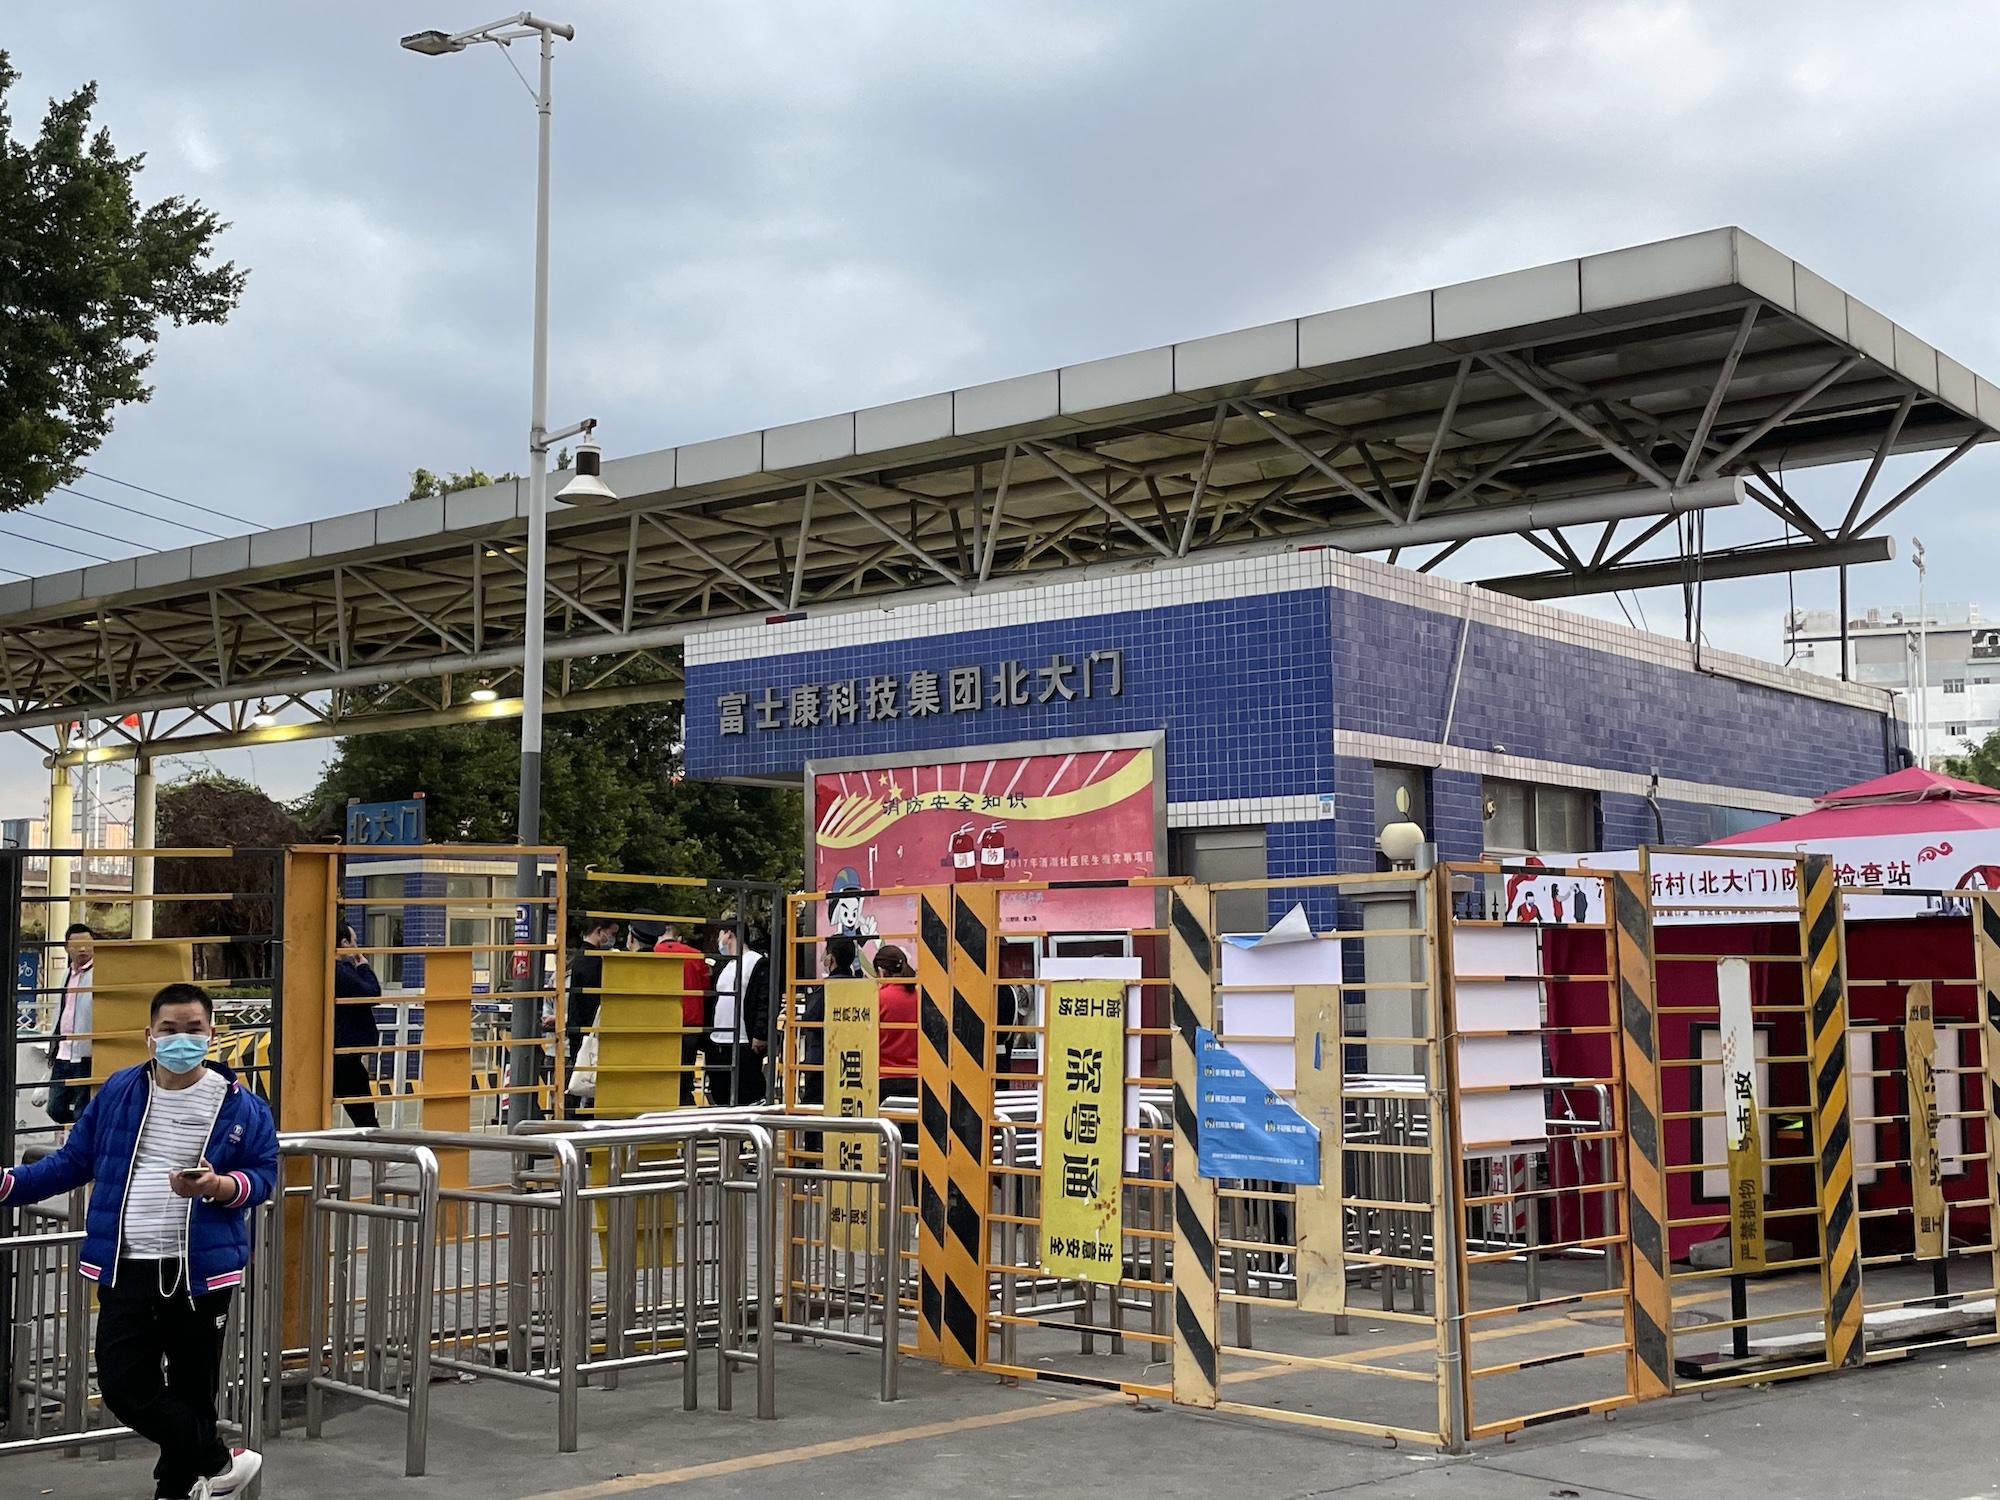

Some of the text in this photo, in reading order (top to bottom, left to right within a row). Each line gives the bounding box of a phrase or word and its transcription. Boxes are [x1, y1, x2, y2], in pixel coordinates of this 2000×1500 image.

[717, 650, 1124, 735] 富士康科技集团北大门
[882, 791, 1028, 816] 消防安全知识
[350, 806, 419, 844] 北大门
[832, 1007, 871, 1022] 注意安全
[1058, 997, 1122, 1018] 施工现场
[1062, 1047, 1103, 1199] 深粤通
[1050, 1235, 1113, 1263] 注意安全
